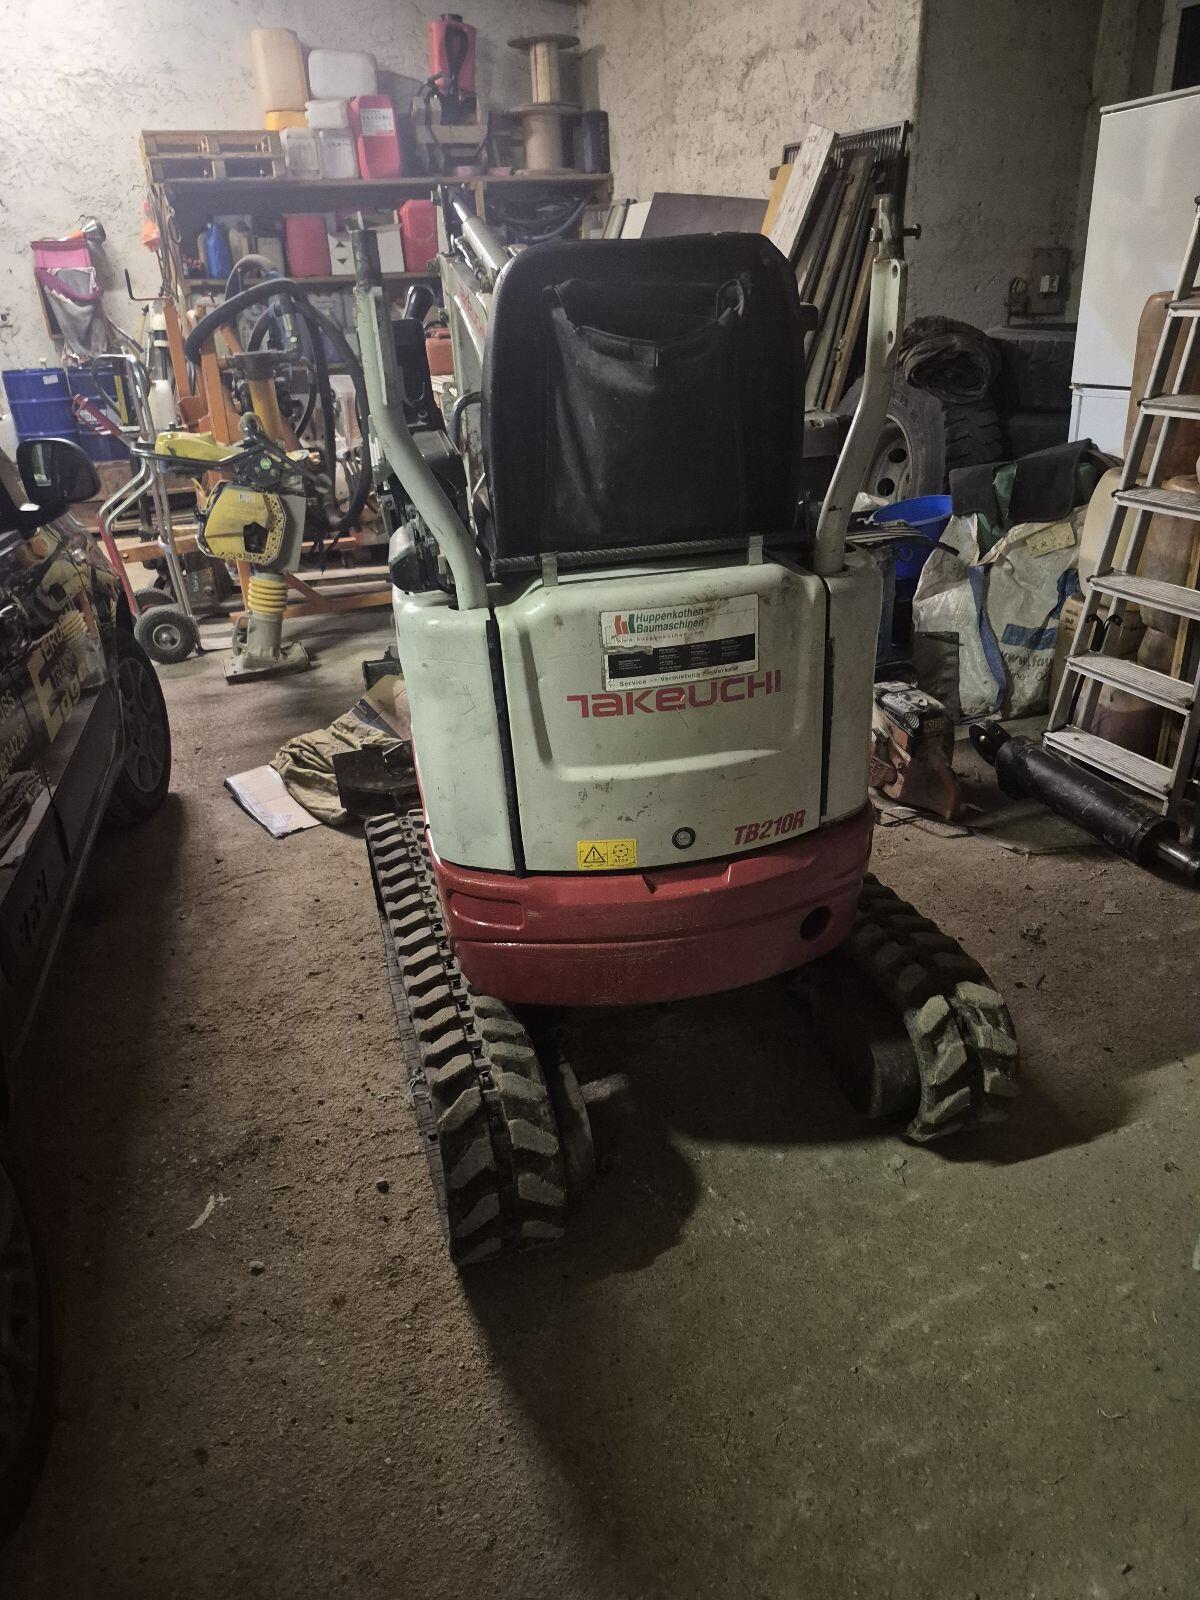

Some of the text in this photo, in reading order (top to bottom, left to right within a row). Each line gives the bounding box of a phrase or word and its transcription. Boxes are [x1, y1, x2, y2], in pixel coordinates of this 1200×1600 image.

[635, 607, 705, 624] Huppenkothen
[636, 618, 705, 634] Baumaschinen
[619, 679, 647, 687] Service
[660, 672, 701, 683] Vermietung
[734, 808, 806, 846] TB210R
